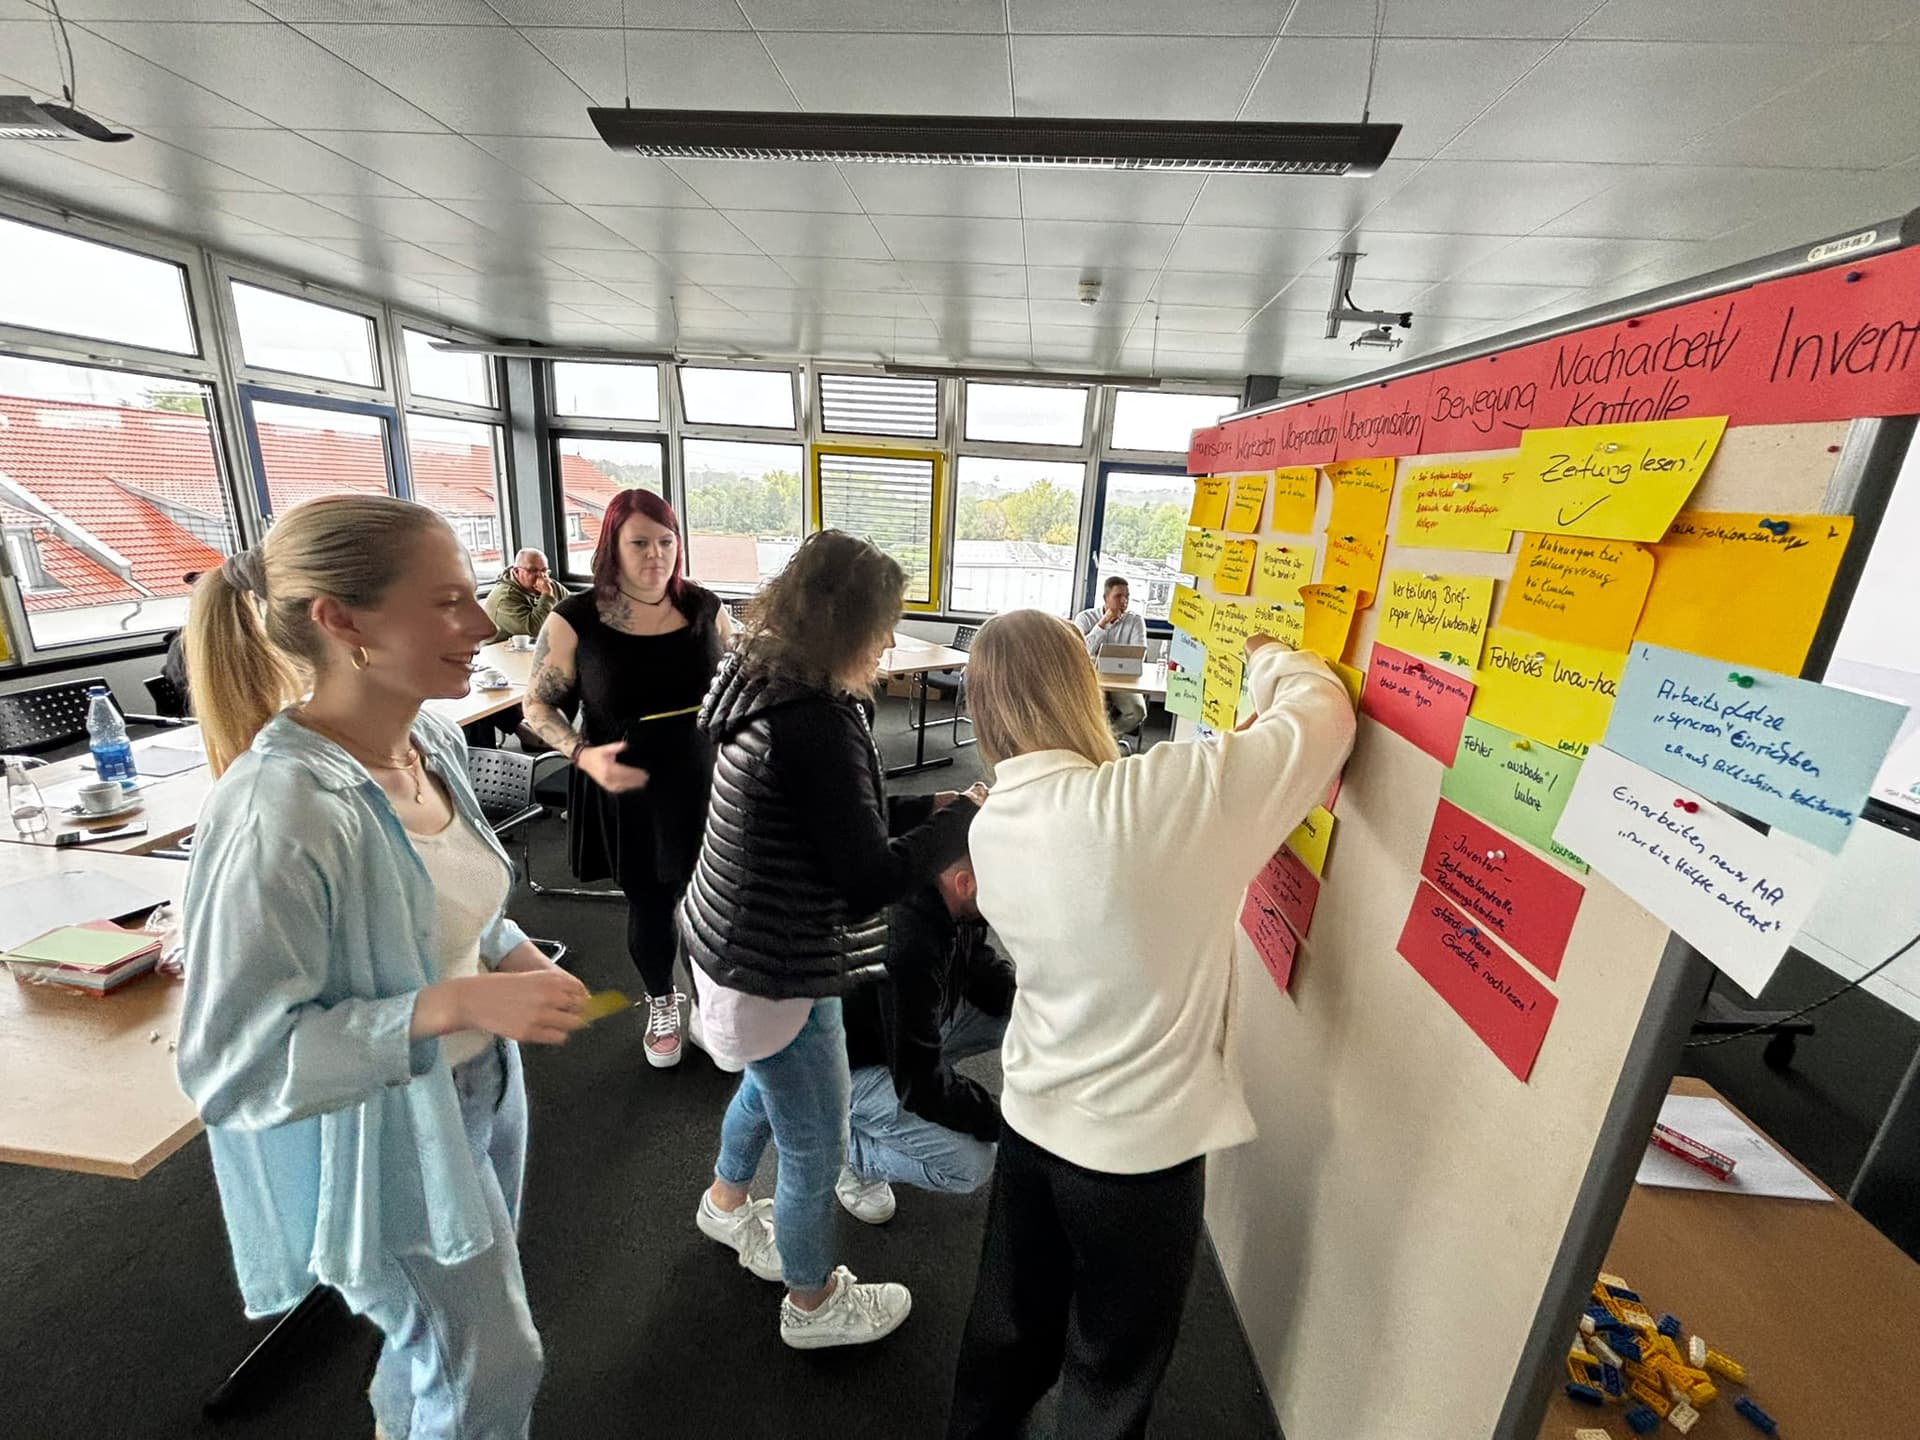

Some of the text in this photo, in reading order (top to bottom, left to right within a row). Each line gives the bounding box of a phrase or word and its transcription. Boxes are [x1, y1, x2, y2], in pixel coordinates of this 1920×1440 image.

[1431, 382, 1537, 433] Bewegung
[1565, 377, 1690, 427] Kontrolle
[1540, 454, 1632, 484] Zeitung
[1489, 646, 1543, 678] Fehlendes
[1464, 735, 1494, 758] Fehler
